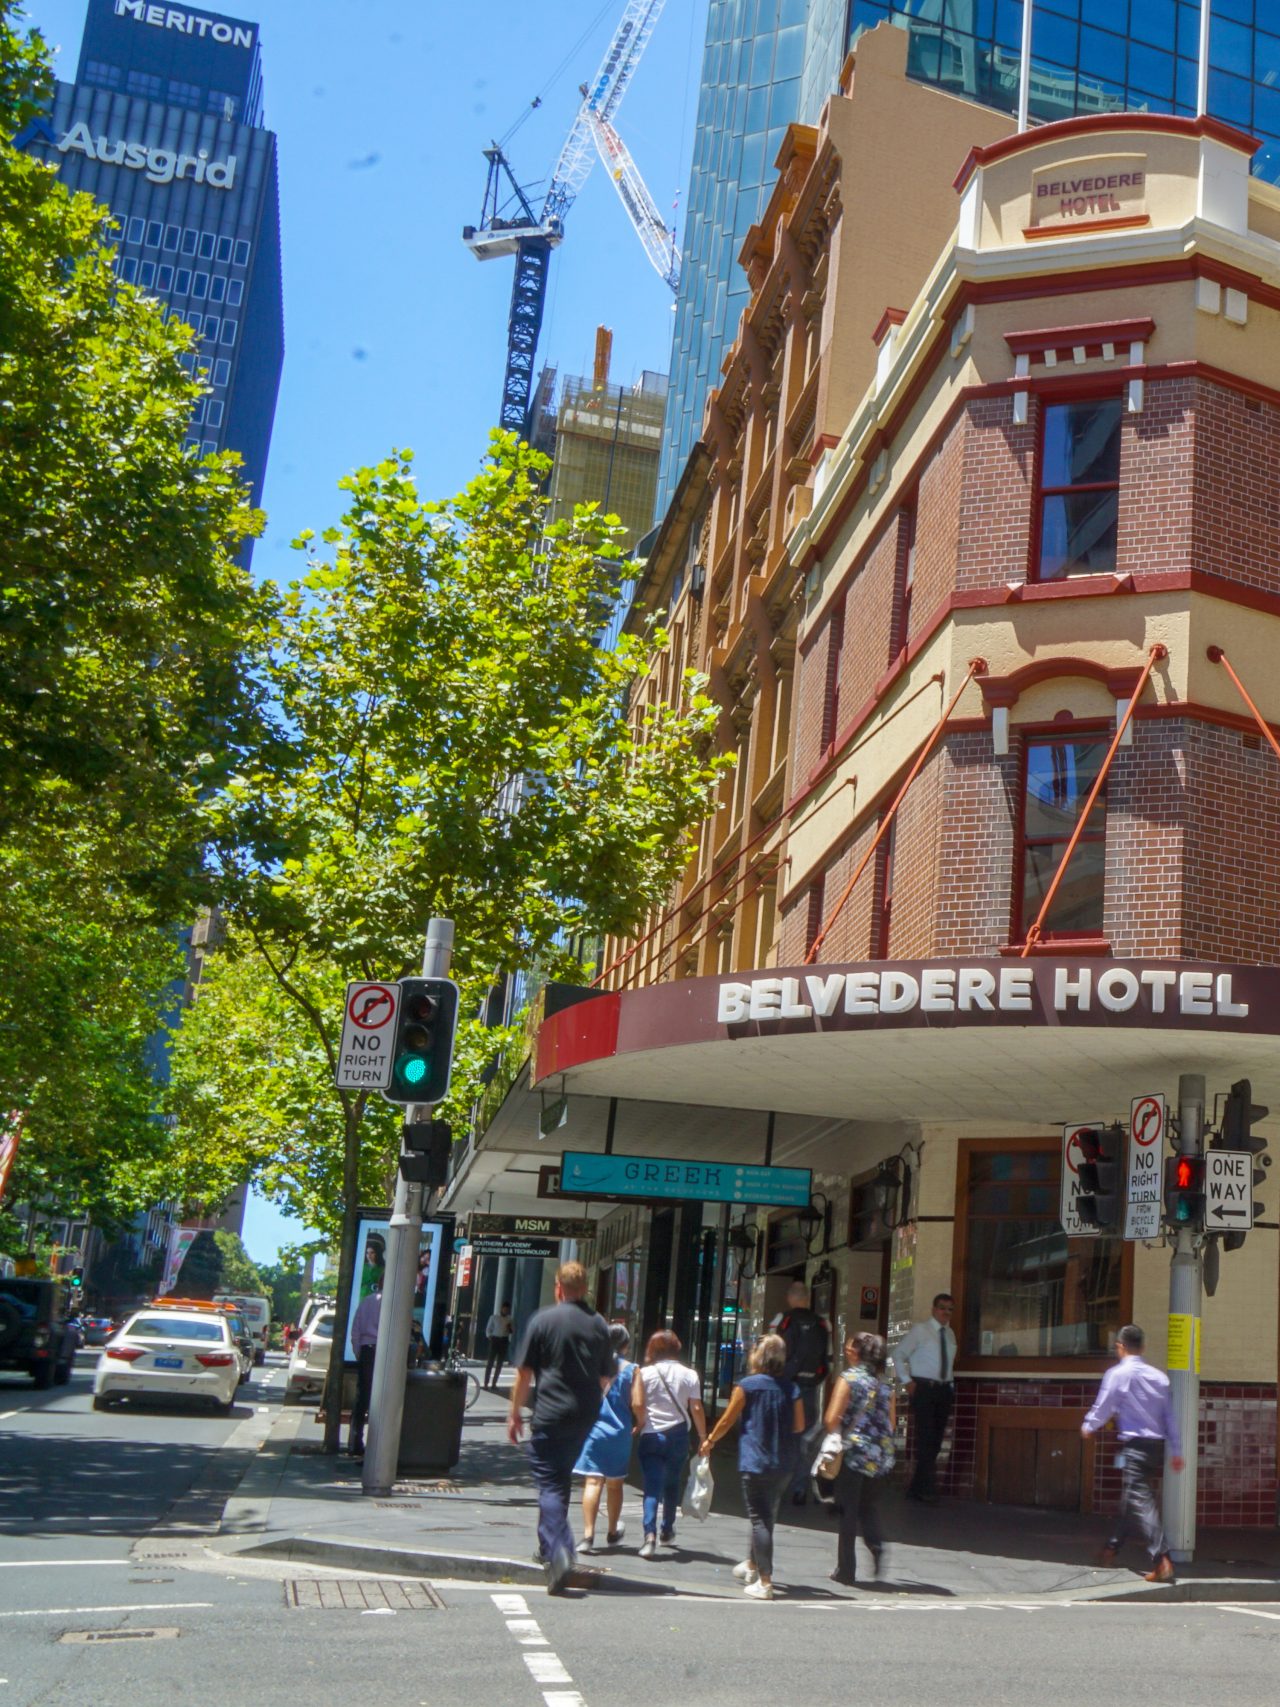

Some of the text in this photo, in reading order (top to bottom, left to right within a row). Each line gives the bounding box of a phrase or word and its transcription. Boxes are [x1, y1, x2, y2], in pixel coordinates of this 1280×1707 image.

[114, 0, 252, 48] MERITON
[588, 20, 634, 111] PROBUILD
[57, 121, 237, 189] Ausgrid
[1037, 172, 1142, 198] BELVEDERE
[1060, 193, 1120, 216] HOTEL
[717, 967, 1249, 1024] BELVEDERE HOTEL
[352, 1035, 381, 1051] NO
[344, 1055, 387, 1067] RIGHT
[344, 1070, 382, 1081] TURN
[1136, 1152, 1154, 1169] NO
[1212, 1158, 1245, 1177] ONE
[625, 1162, 722, 1186] GREEK
[1131, 1173, 1158, 1187] RIGHT
[1131, 1190, 1156, 1202] TURN
[1210, 1182, 1247, 1200] WAY
[1136, 1204, 1152, 1214] FROM
[515, 1219, 550, 1231] MSM
[1131, 1215, 1155, 1225] BICYCLE
[1134, 1227, 1149, 1236] PATH
